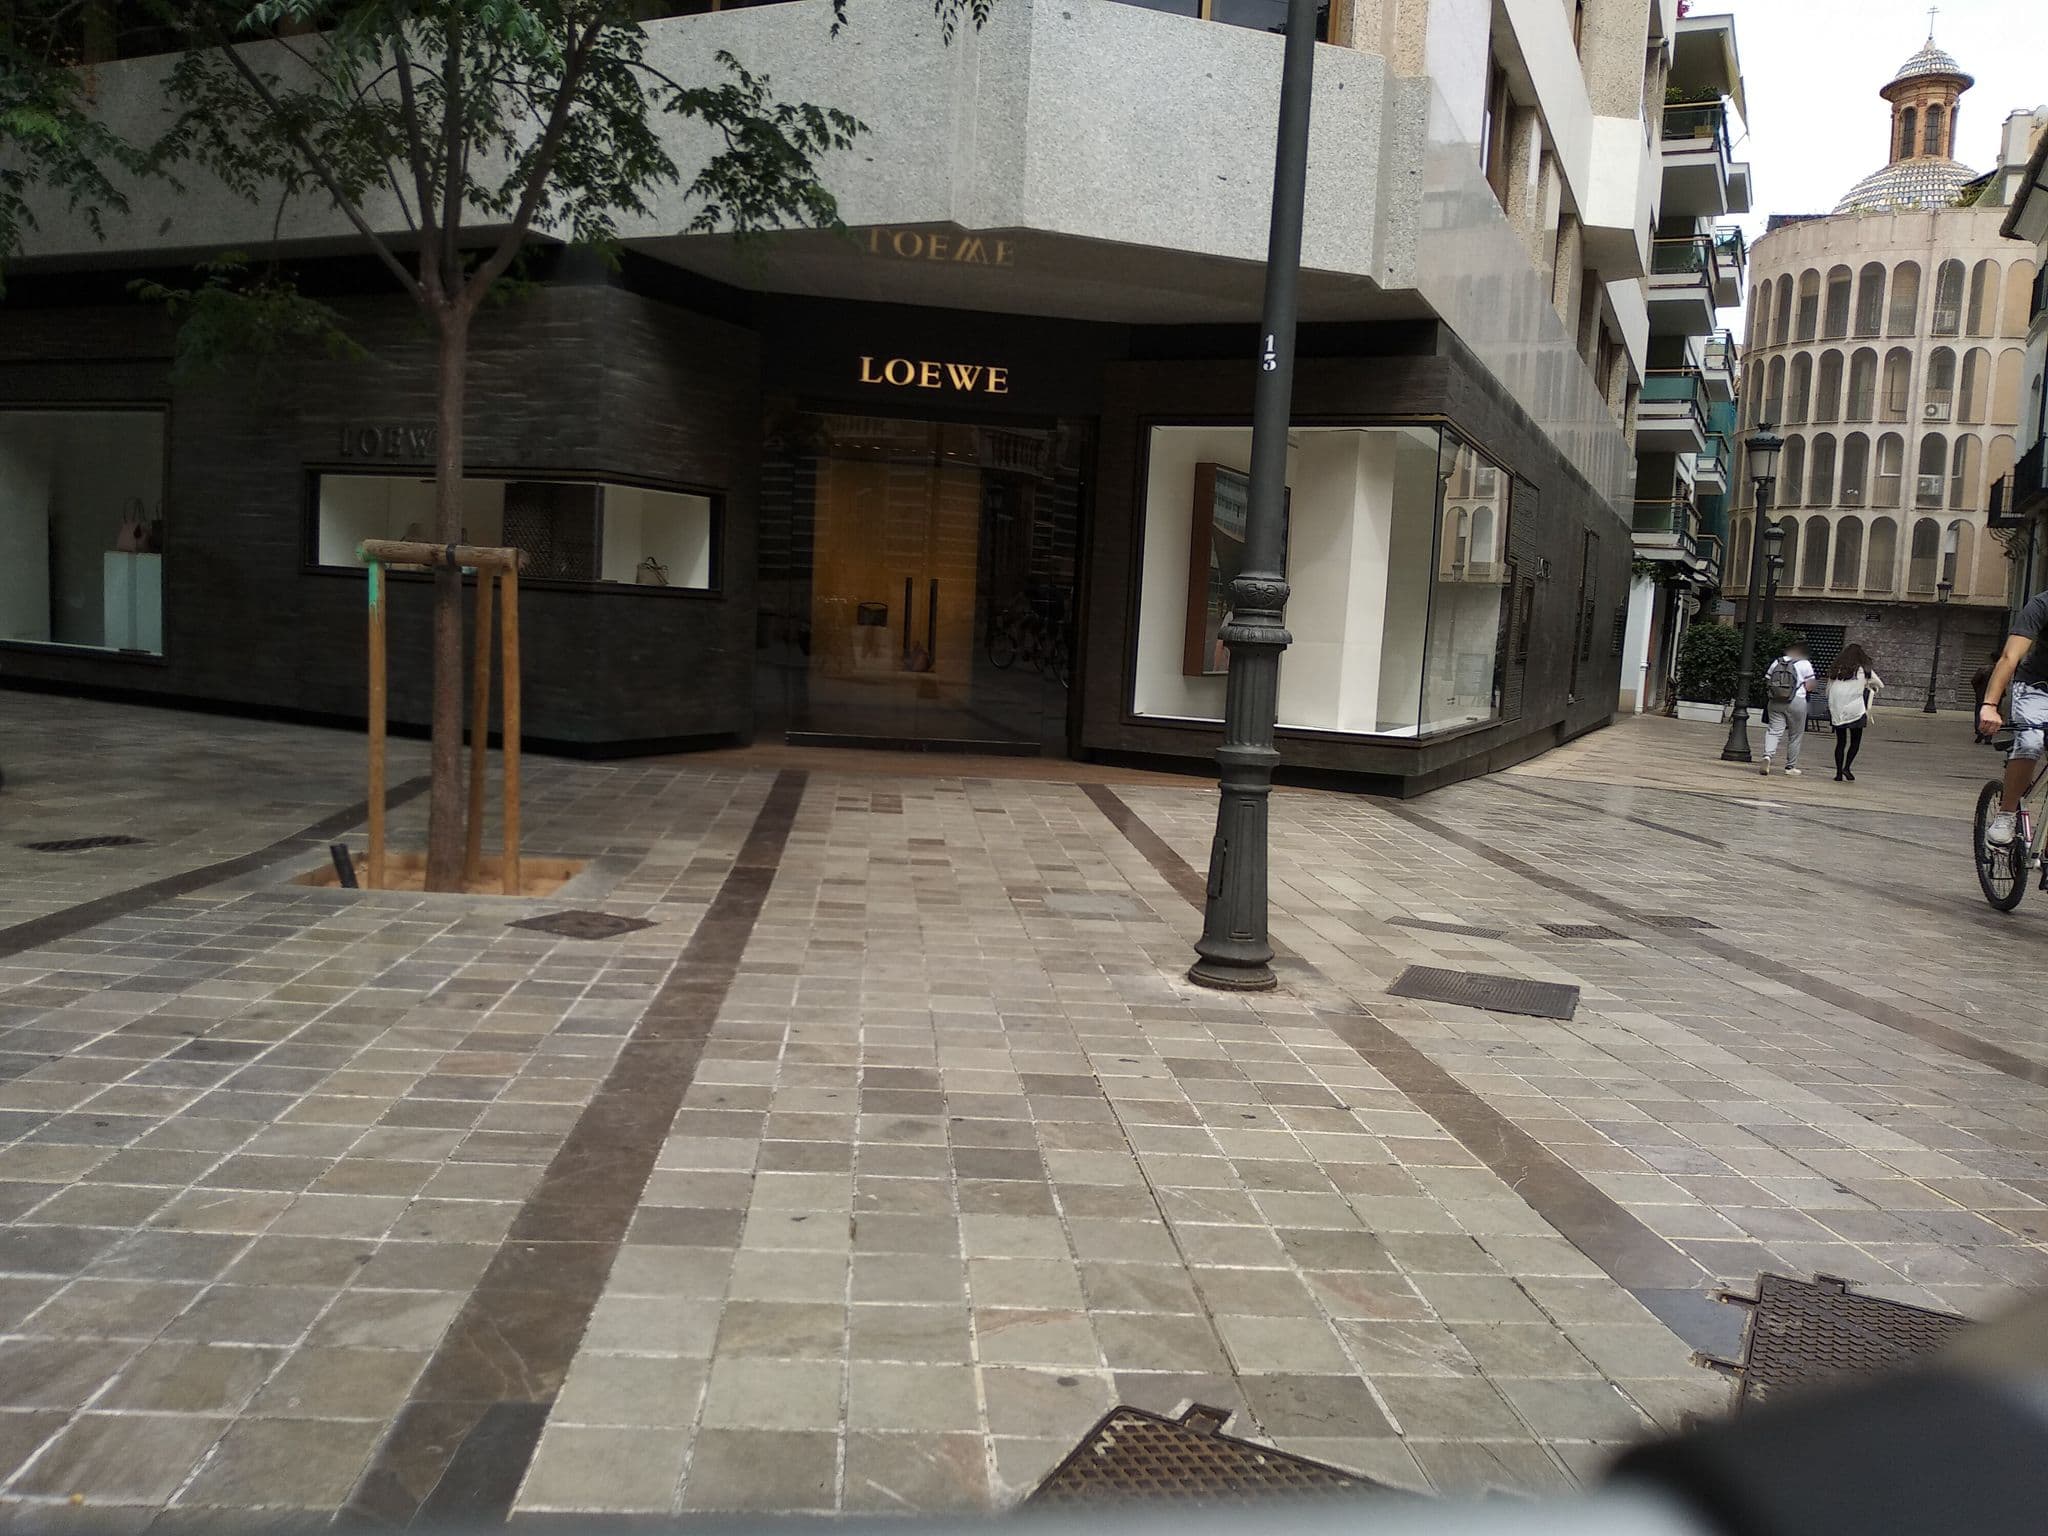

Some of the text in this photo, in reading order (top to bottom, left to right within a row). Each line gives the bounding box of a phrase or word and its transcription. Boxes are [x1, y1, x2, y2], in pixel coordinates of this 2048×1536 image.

[1263, 334, 1276, 370] 15
[859, 356, 1009, 394] LOEWE
[341, 425, 439, 457] LOEW
